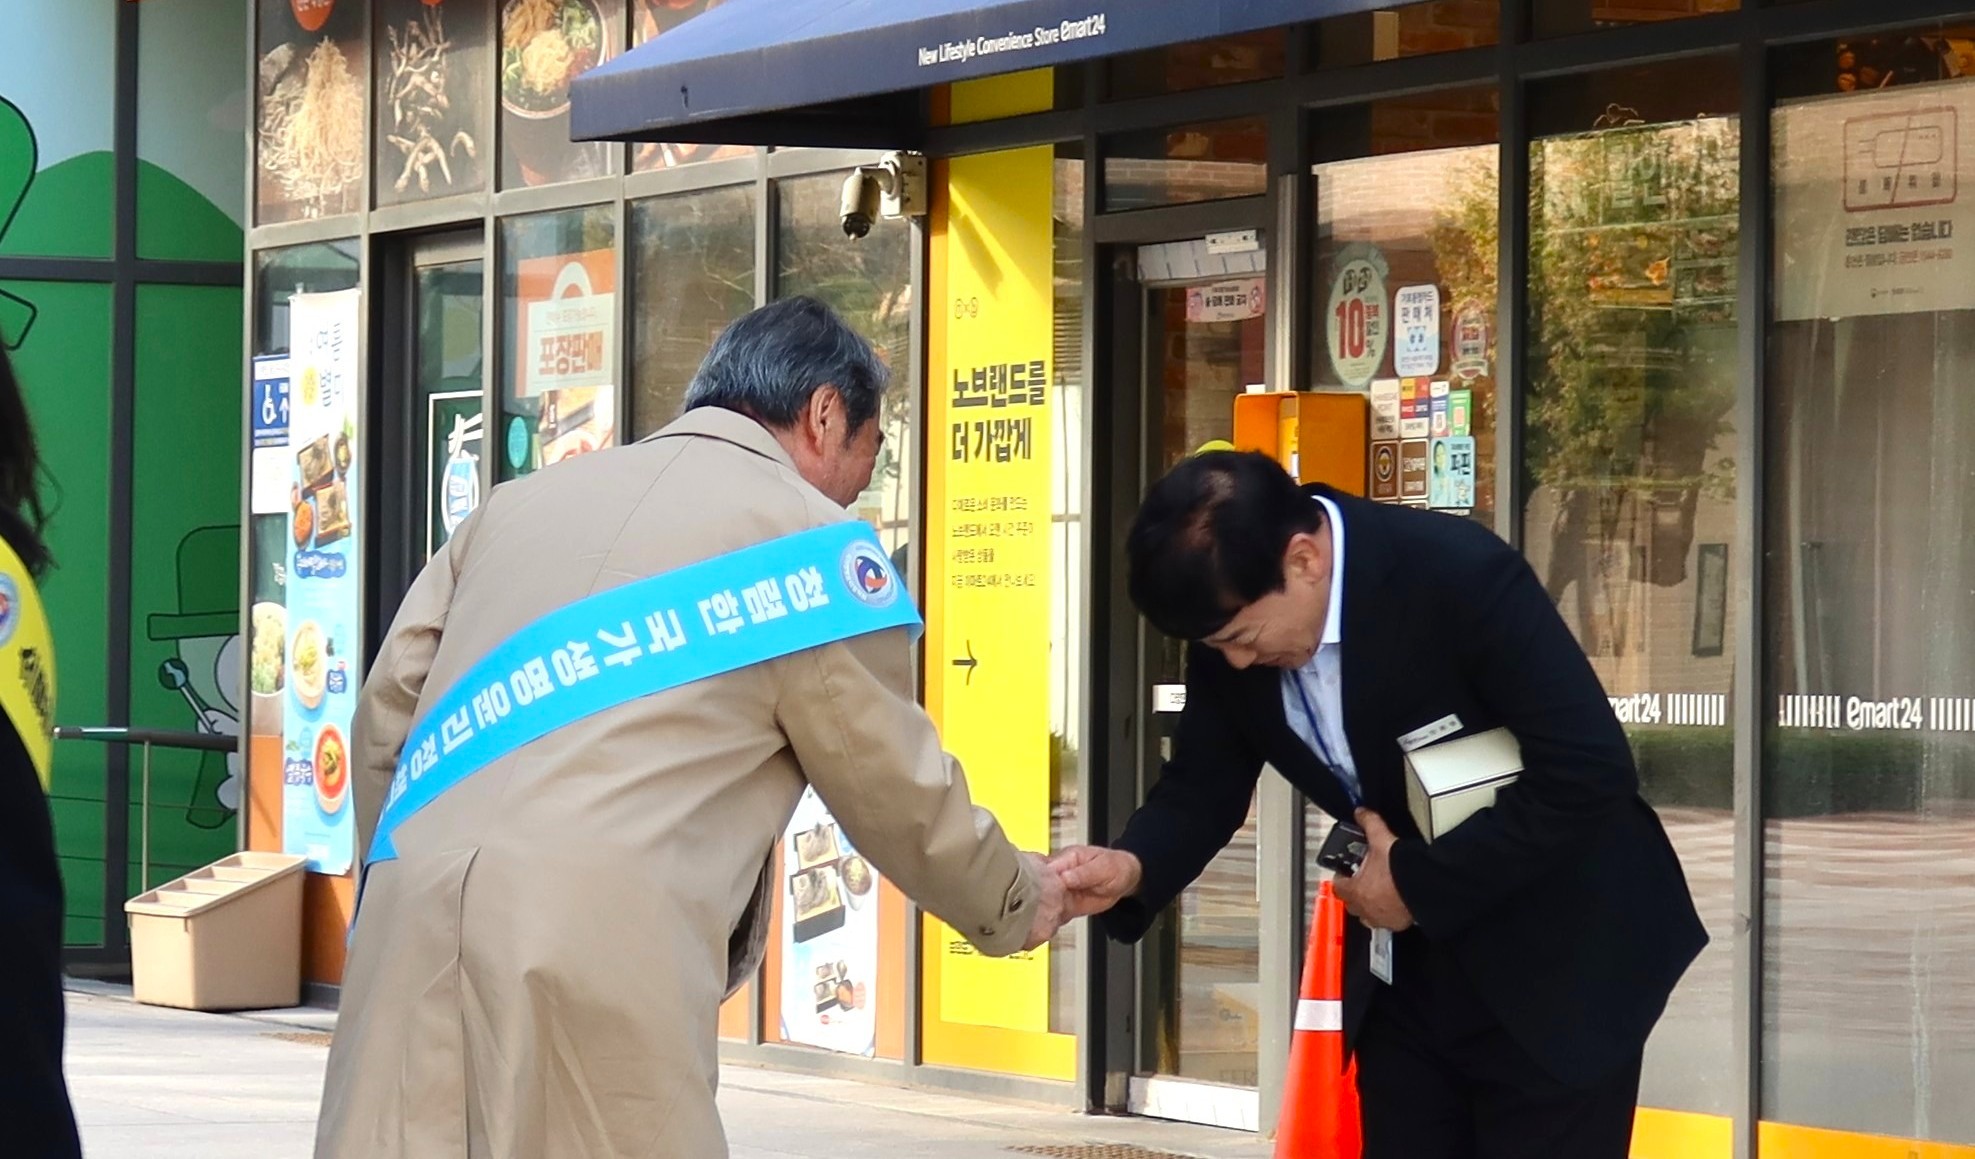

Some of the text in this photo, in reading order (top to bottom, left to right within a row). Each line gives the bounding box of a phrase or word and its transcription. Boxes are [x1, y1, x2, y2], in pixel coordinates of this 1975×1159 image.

[918, 13, 1106, 66] New Lifestyle Convenience Store emart24
[1912, 219, 1953, 242] 없습니다
[1335, 298, 1365, 360] 10
[539, 331, 603, 376] 포장판매
[952, 360, 1047, 408] 노브랜드를
[952, 417, 1032, 463] 더 가깝게
[697, 565, 830, 637] 청렴한
[377, 608, 688, 826] 국가생명윤리정책
[1606, 692, 1662, 724] mart24
[1847, 695, 1923, 730] emart24
